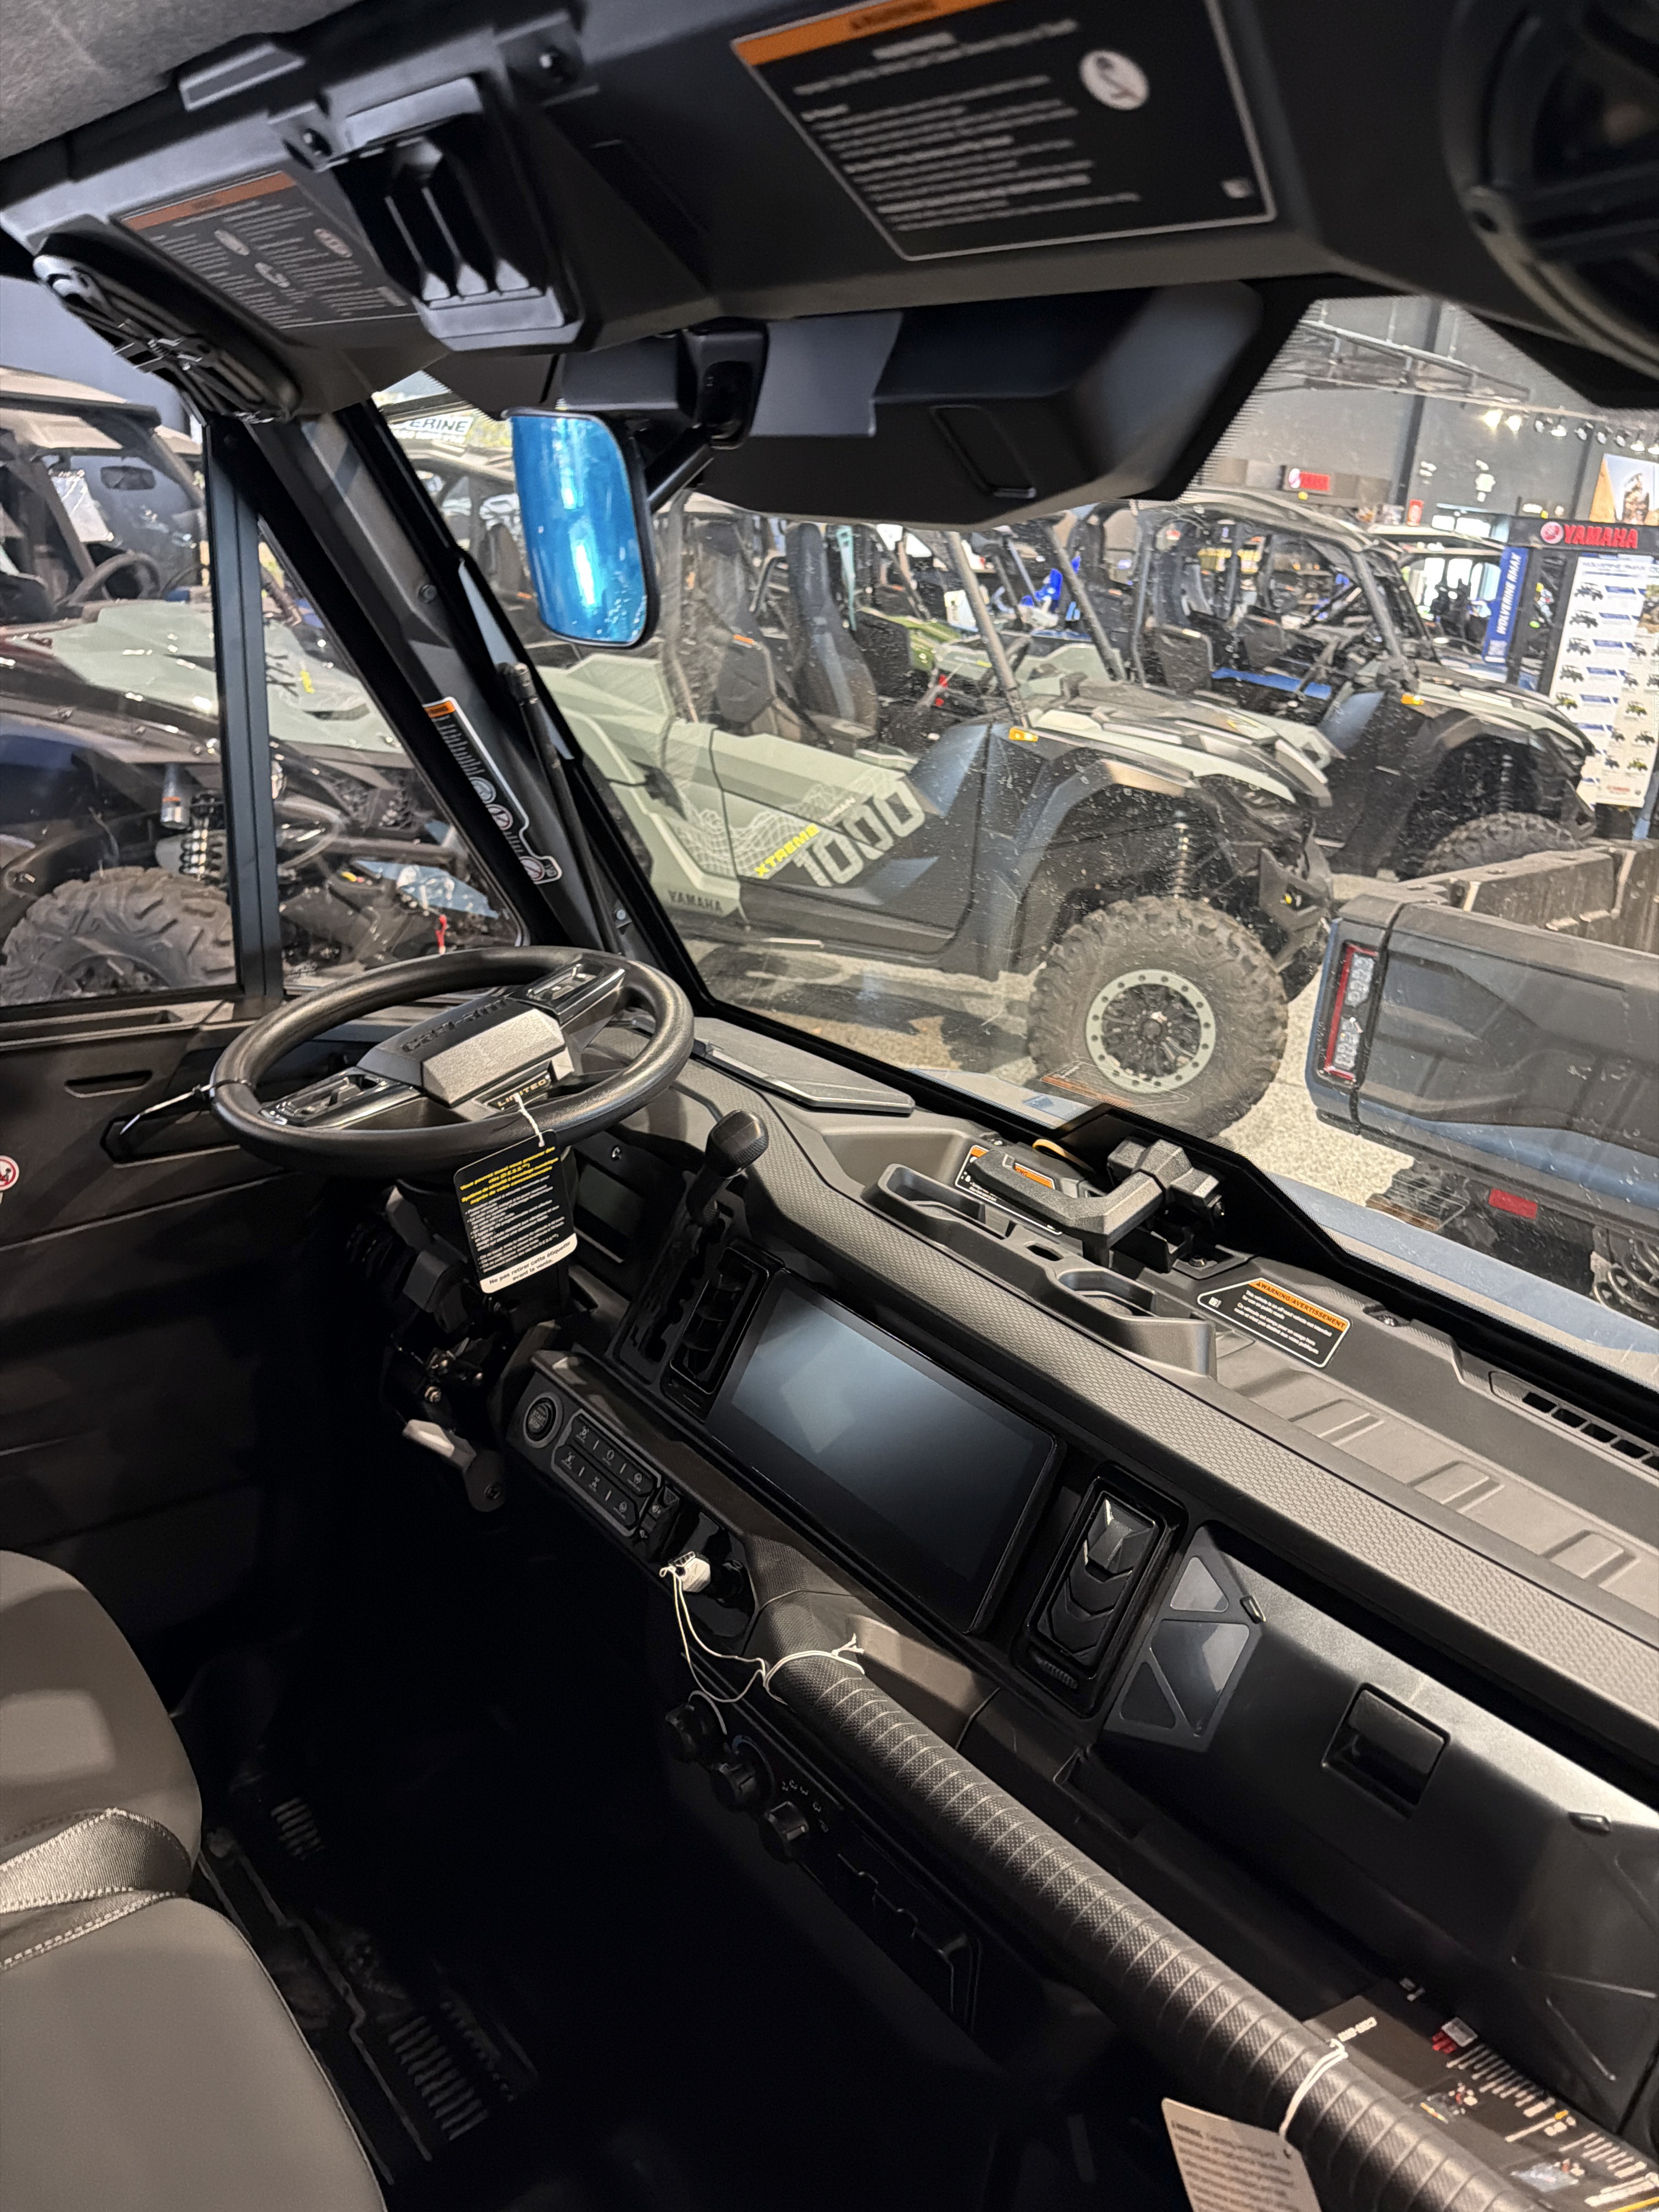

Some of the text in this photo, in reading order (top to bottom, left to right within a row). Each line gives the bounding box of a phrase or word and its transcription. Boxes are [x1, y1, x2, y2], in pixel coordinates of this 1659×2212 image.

[408, 418, 469, 432] ERINE
[1564, 524, 1638, 549] YAMAHA
[1496, 551, 1522, 635] WOLVERINE RMAX
[793, 780, 926, 888] 1000
[754, 823, 821, 878] XTREME
[668, 890, 724, 912] YAMAHA
[499, 1273, 510, 1282] pas
